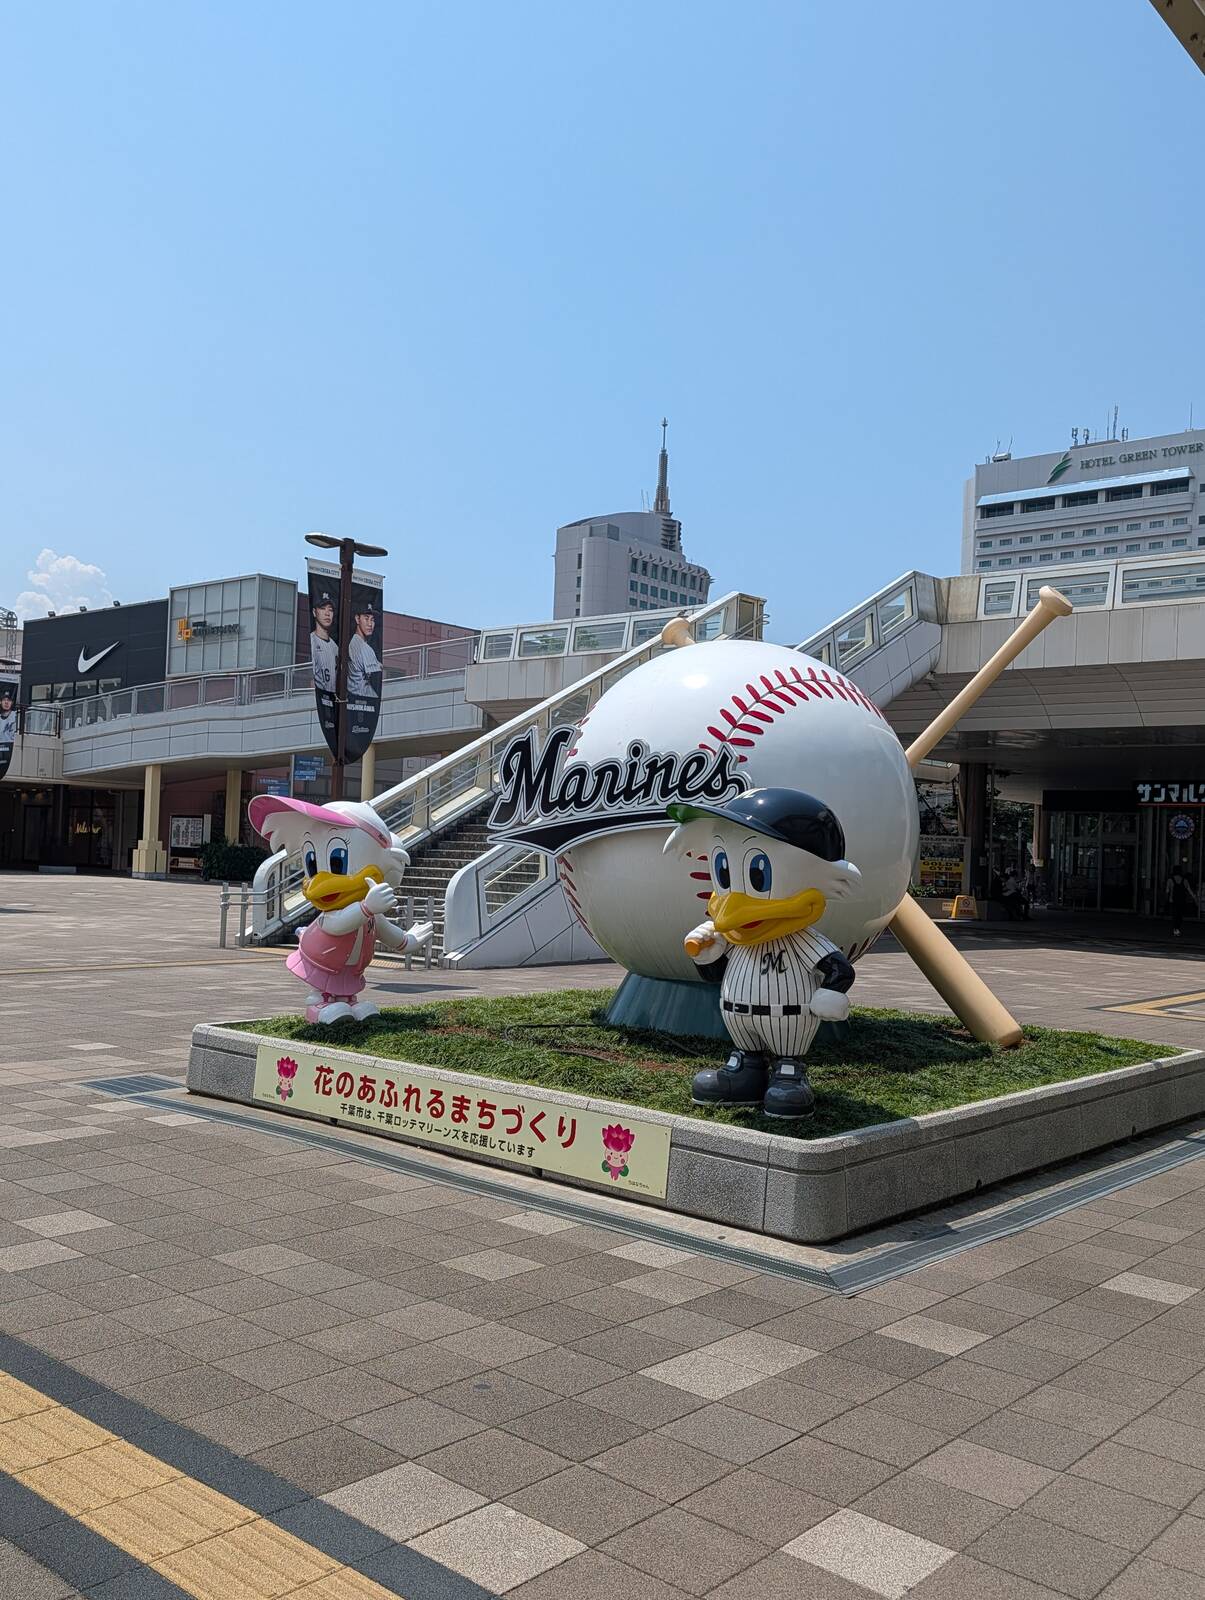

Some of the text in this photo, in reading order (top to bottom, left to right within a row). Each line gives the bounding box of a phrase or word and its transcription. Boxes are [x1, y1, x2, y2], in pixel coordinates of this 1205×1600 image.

[1080, 442, 1204, 470] HOTEL GREEN TOWER
[321, 668, 331, 683] 16
[488, 725, 750, 829] Marines
[761, 950, 788, 975] M
[314, 1065, 577, 1149] 花のあふれるまちづくり
[340, 1102, 536, 1158] 千葉市は、千葉ロッテマリーンズを応援しています
